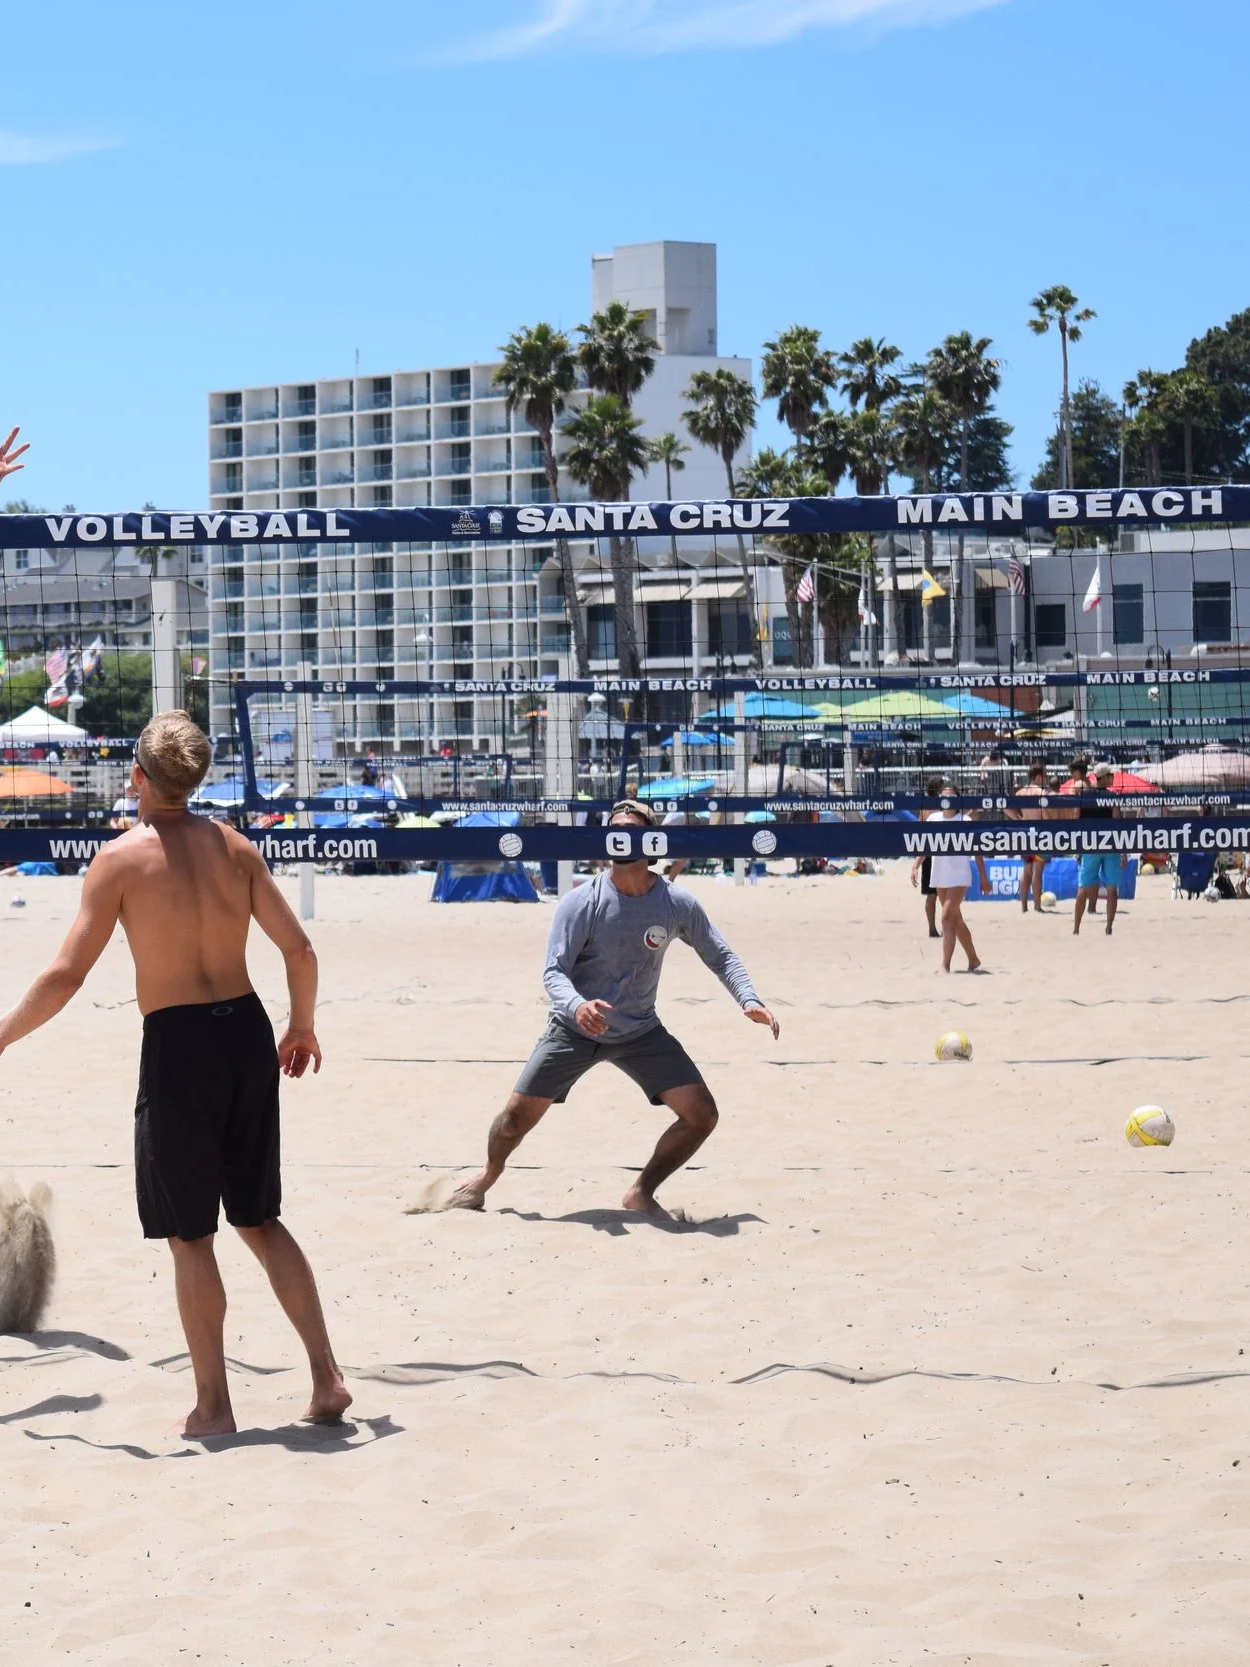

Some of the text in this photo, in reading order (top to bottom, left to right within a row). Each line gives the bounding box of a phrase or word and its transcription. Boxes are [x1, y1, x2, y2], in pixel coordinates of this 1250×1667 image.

[44, 513, 350, 541] VOLLEYBALL
[516, 505, 658, 533] SANTA
[669, 502, 791, 530] CRUZ
[897, 496, 1023, 524] MAIN
[1048, 490, 1223, 519] BEACH
[454, 670, 1211, 693] SANTA CRUZ MAIN BEACH VOLLEYBALL SANTA CRUZ MAIN BEACH
[761, 717, 1227, 732] SANTA CRUZ MAIN BEACH VOLLEYBALL SANTA CRUZ MAIN BEACH
[58, 738, 129, 748] VOLLEYBALL
[441, 800, 569, 812] www.santacruzwharf.com
[763, 799, 895, 811] www.santacruzwharf.com
[1096, 795, 1231, 808] www.santacruzwharf.com
[903, 823, 1250, 852] www.santacruzwharf.com
